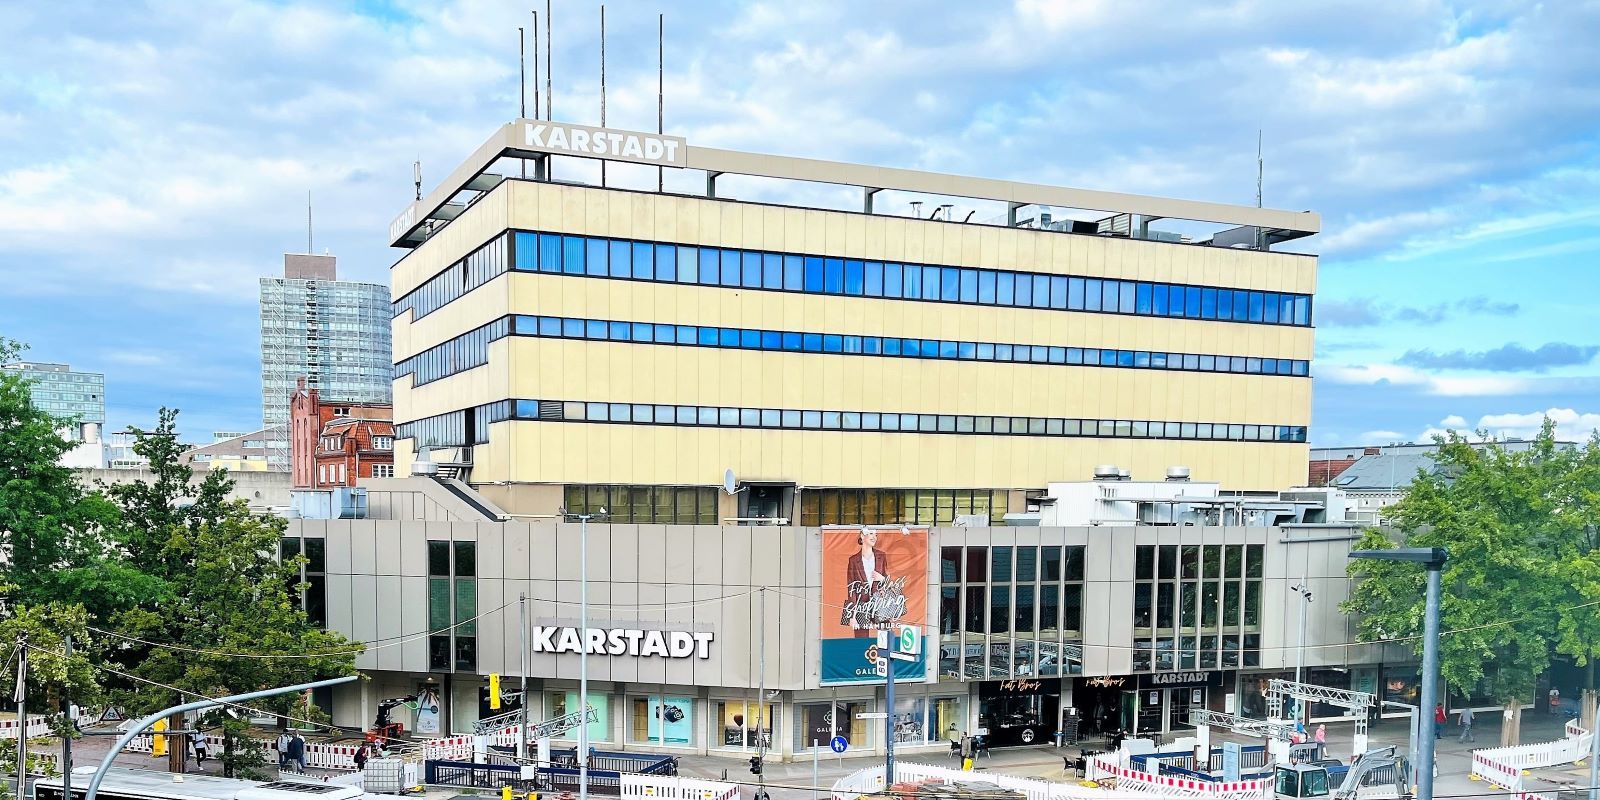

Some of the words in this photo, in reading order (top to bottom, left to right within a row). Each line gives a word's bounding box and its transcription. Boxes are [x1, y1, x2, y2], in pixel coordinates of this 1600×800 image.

[524, 123, 679, 162] KARSTADT
[848, 580, 873, 597] First
[846, 594, 908, 621] shopping
[863, 622, 900, 630] HAMBURG
[532, 625, 715, 659] KARSTADT
[902, 627, 914, 651] S
[1018, 679, 1041, 691] Bros
[1152, 672, 1209, 684] KARSTADT
